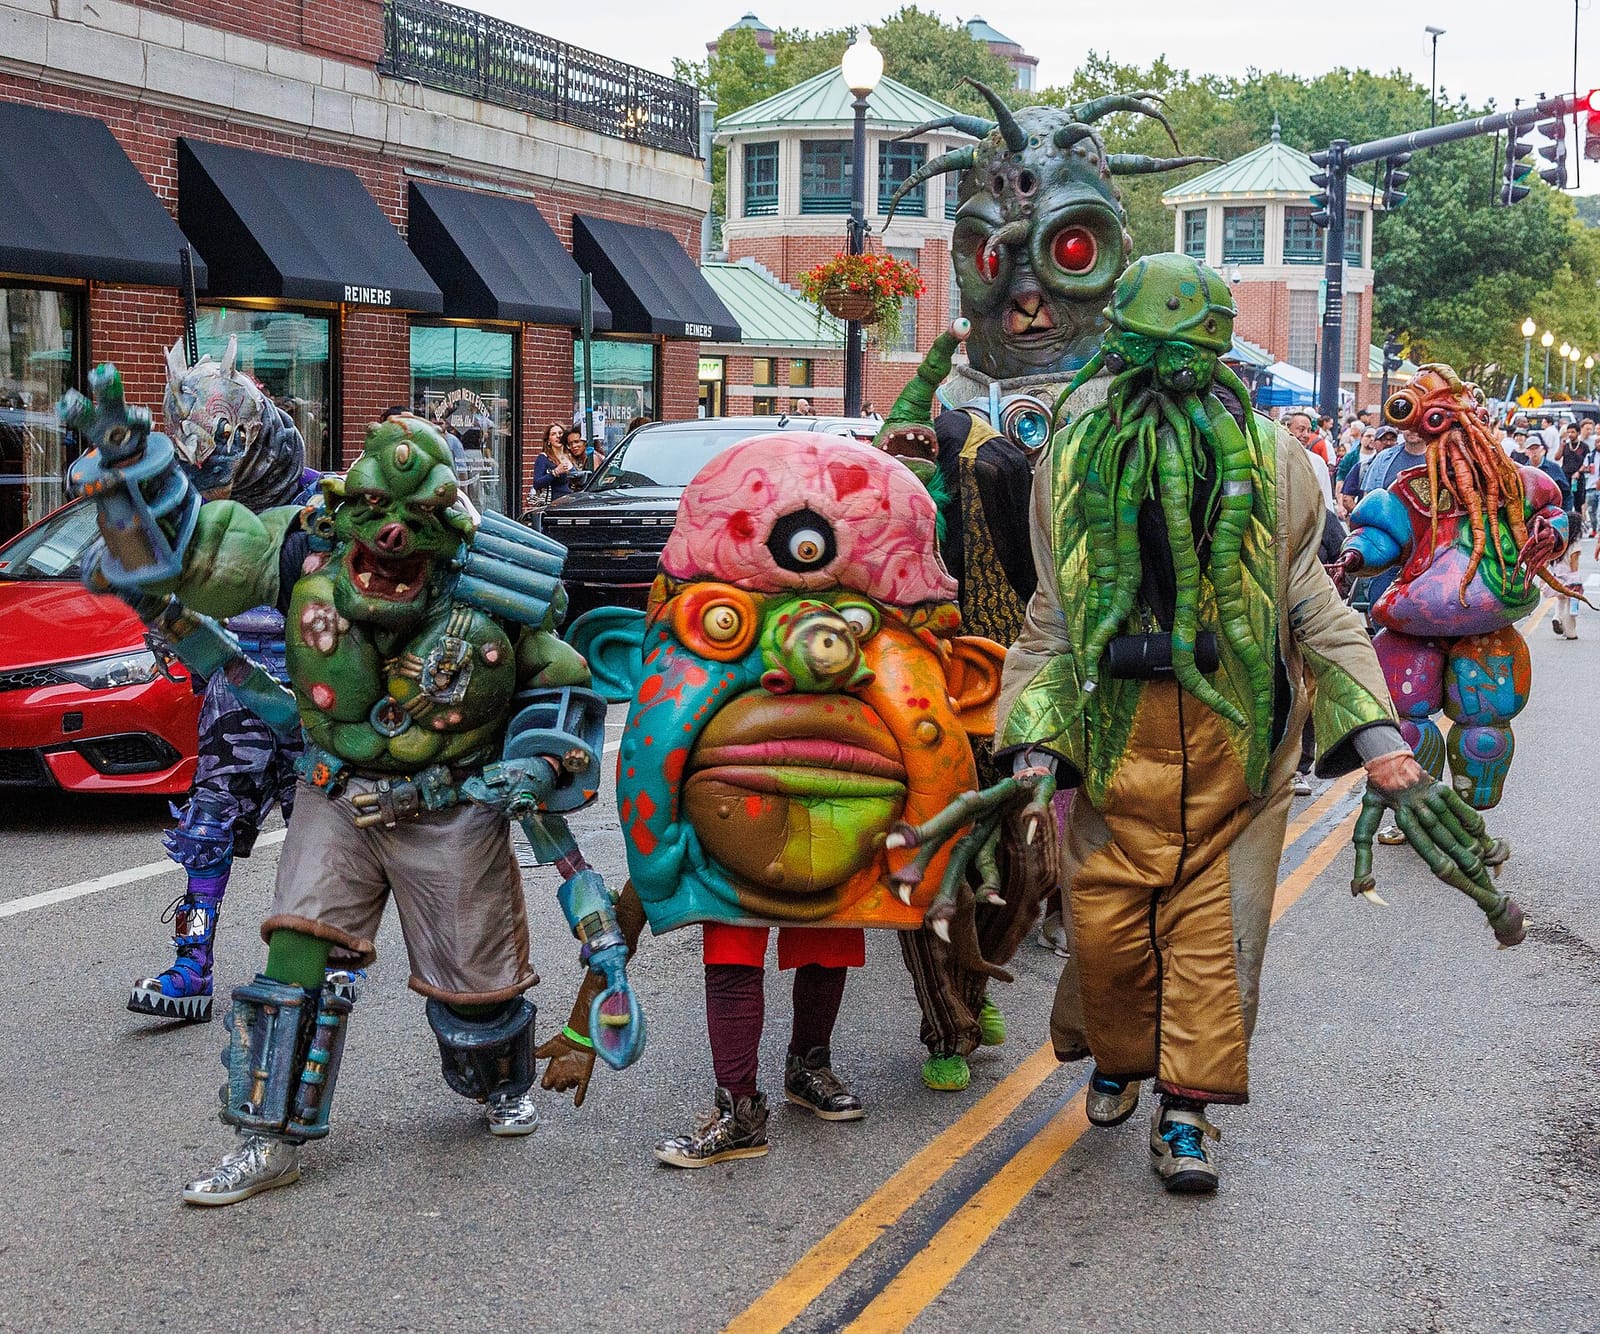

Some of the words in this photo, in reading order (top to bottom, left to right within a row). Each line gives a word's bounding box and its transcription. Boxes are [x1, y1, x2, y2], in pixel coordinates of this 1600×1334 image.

[344, 285, 391, 305] REINERS
[684, 323, 713, 338] REINERS
[462, 388, 475, 403] NEXT
[597, 405, 632, 420] REINERS
